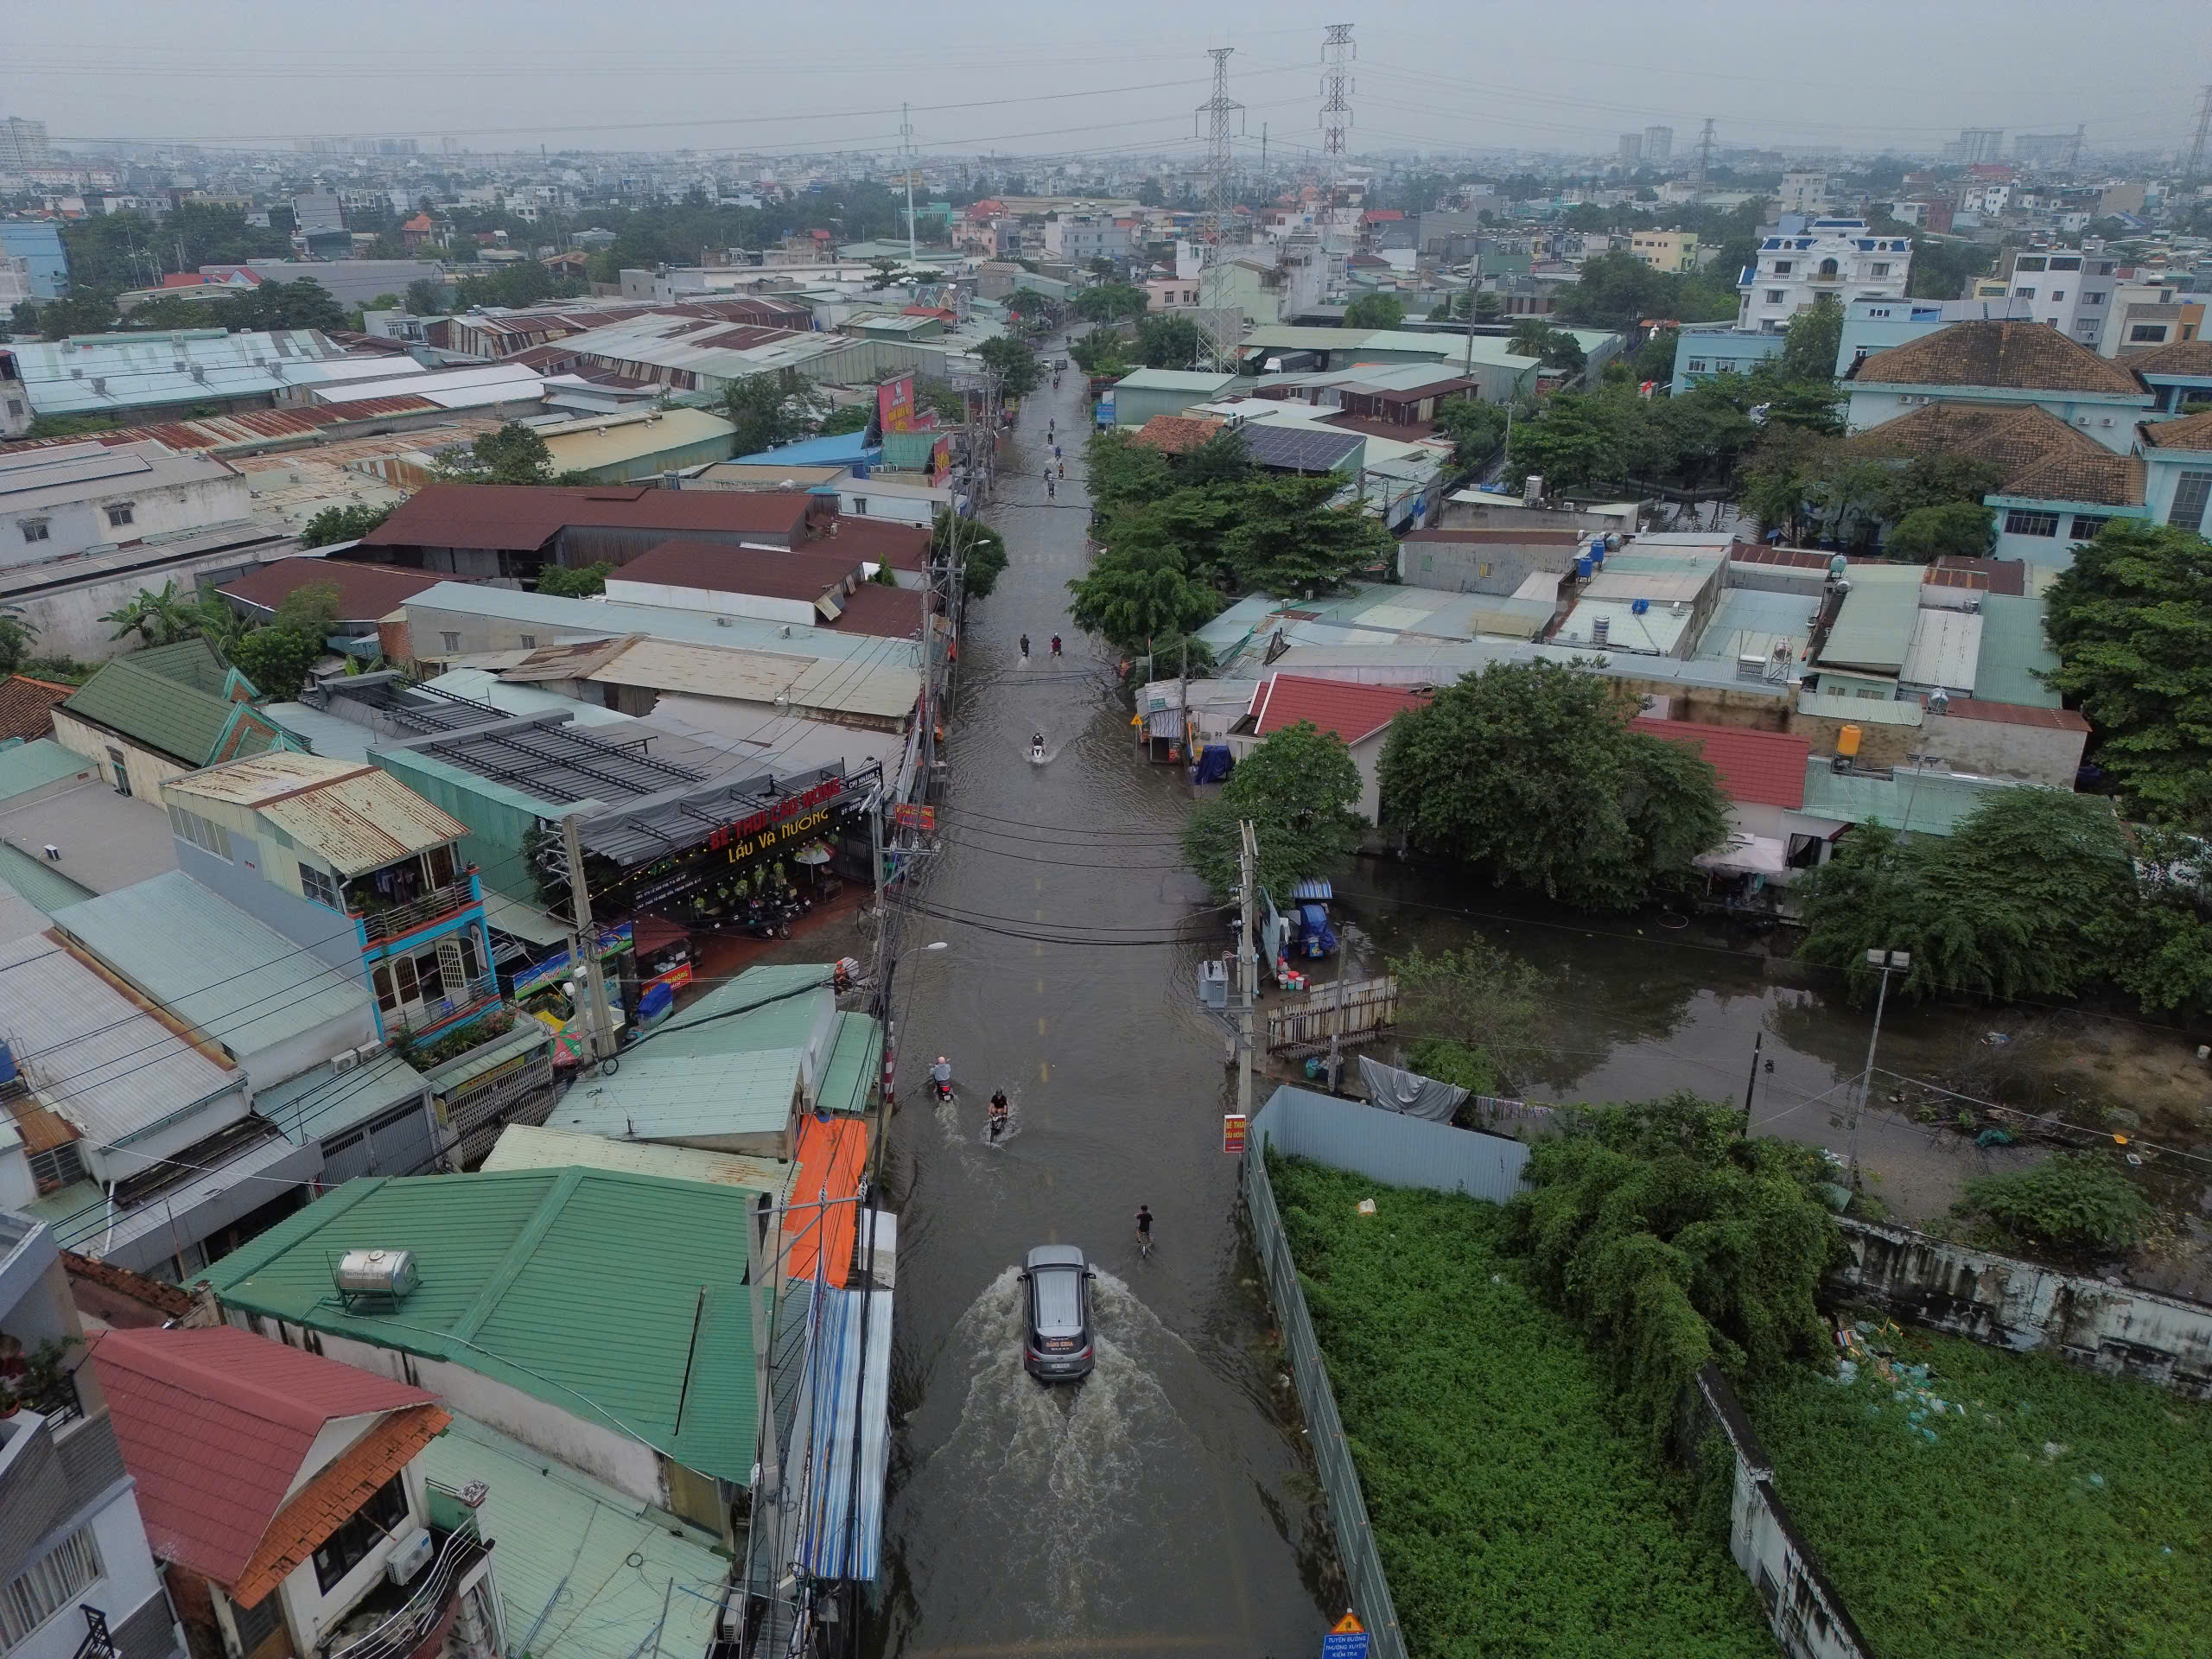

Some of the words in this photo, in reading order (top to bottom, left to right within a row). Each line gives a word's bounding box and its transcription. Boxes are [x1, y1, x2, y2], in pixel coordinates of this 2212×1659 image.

[728, 840, 753, 864] LẨU
[758, 830, 776, 849] VÀ
[781, 808, 830, 839] NƯỚNG
[467, 1075, 486, 1088] ANH
